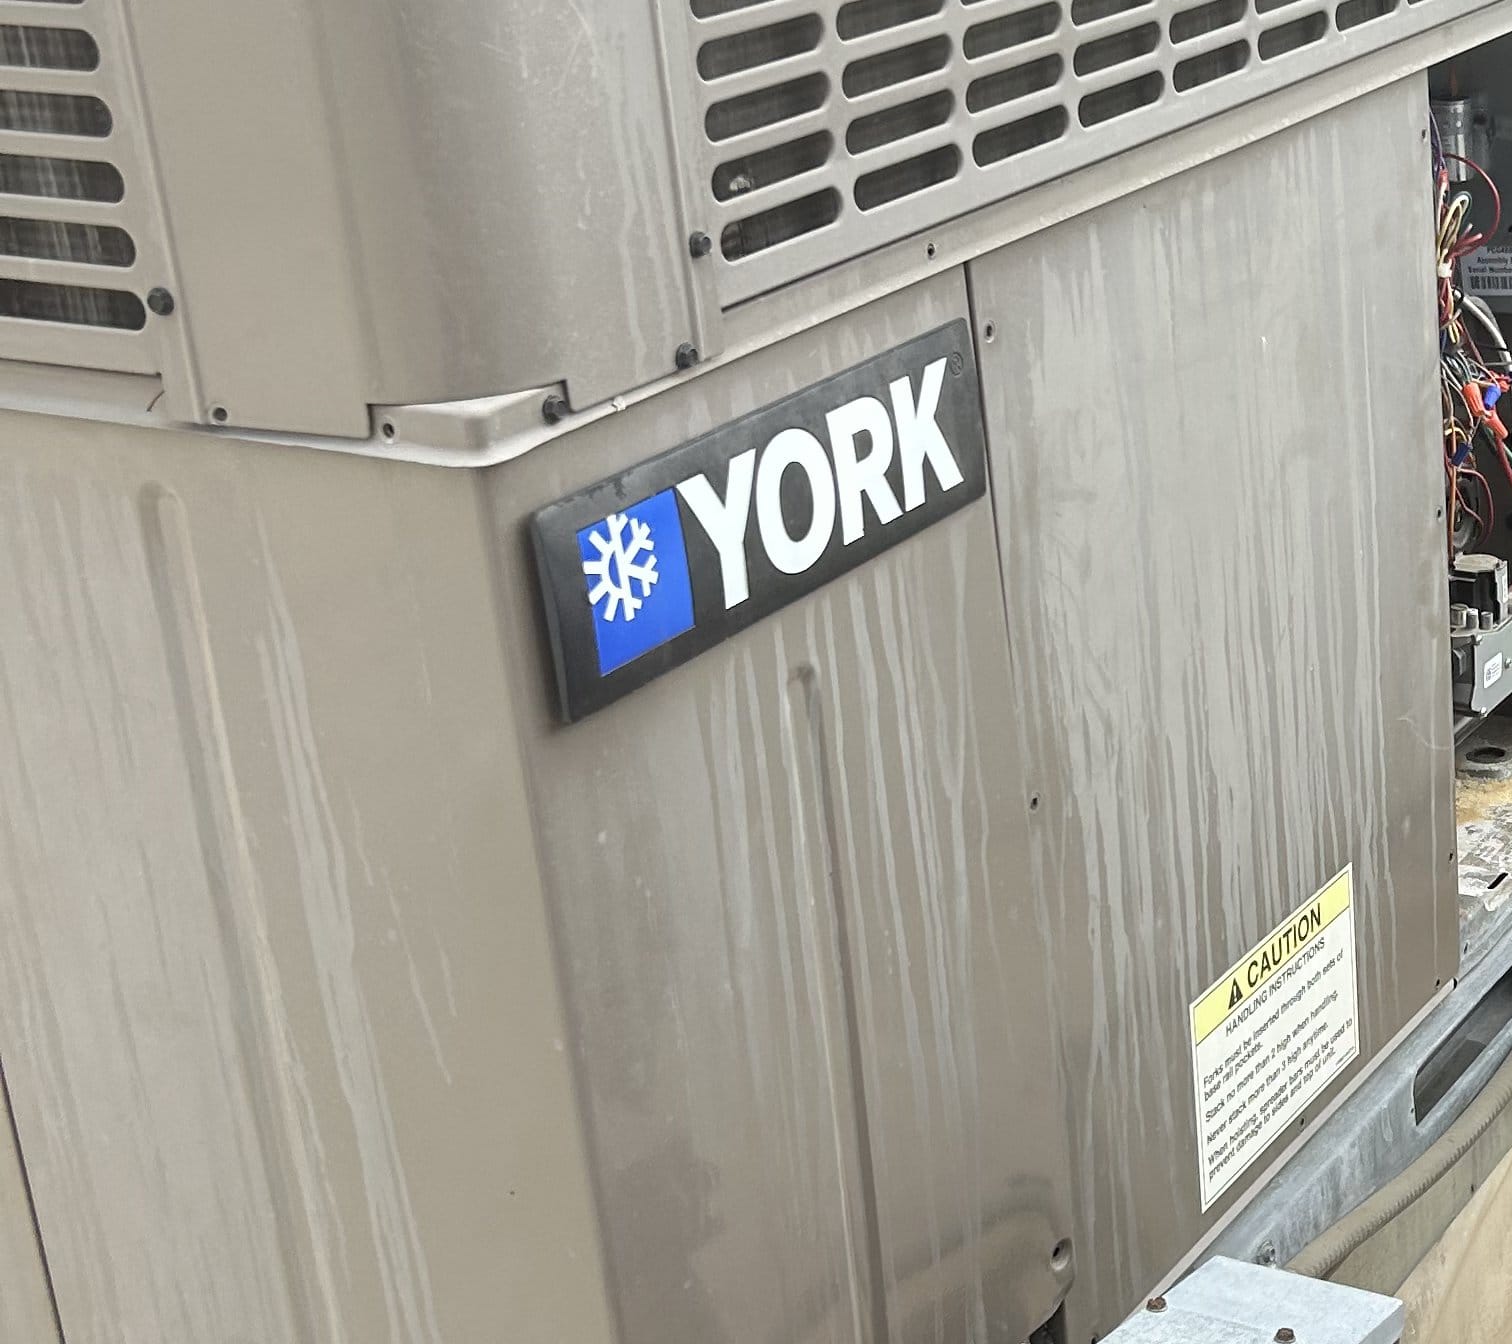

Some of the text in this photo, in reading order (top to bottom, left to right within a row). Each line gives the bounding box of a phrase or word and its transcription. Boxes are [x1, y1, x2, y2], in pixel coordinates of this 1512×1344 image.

[676, 356, 965, 610] YORK
[1226, 937, 1325, 1037] HANDLING INSTRUCTIONS
[1247, 903, 1321, 988] CAUTION
[1203, 1064, 1223, 1088] Forks
[1224, 1045, 1242, 1068] must
[1253, 1008, 1279, 1041] inserted
[1281, 985, 1306, 1014] through
[1307, 971, 1321, 990] both
[1205, 1098, 1225, 1123] Stack
[1237, 1071, 1254, 1093] more
[1255, 1055, 1270, 1074] than
[1276, 1034, 1291, 1053] high
[1292, 1017, 1309, 1038] when
[1204, 1080, 1221, 1102] base
[1223, 1066, 1233, 1084] rail
[1207, 1120, 1227, 1145] Never
[1228, 1101, 1247, 1124] stack
[1248, 1083, 1265, 1105] more
[1266, 1067, 1280, 1086] than
[1287, 1047, 1301, 1066] high
[1208, 1142, 1228, 1166] When
[1260, 1082, 1287, 1115] spreader
[1289, 1067, 1303, 1085] bars
[1304, 1048, 1320, 1070] must
[1330, 1023, 1345, 1044] used
[1209, 1147, 1235, 1182] prevent
[1236, 1121, 1262, 1152] damage
[1272, 1094, 1289, 1116] sides
[1290, 1079, 1302, 1098] and
[1303, 1069, 1314, 1084] top
